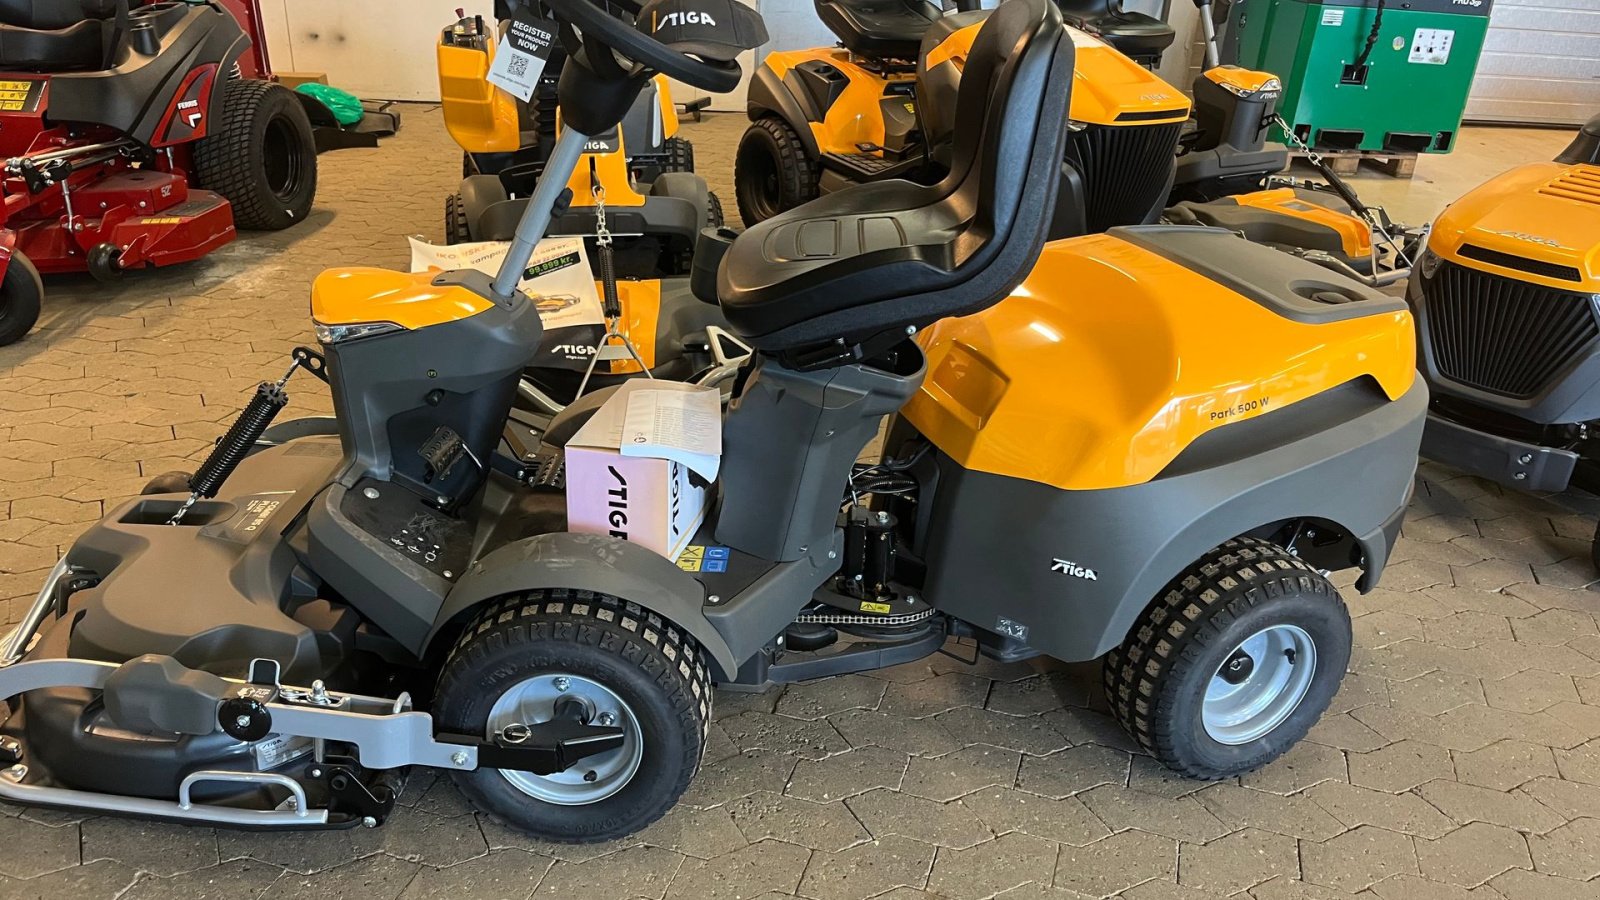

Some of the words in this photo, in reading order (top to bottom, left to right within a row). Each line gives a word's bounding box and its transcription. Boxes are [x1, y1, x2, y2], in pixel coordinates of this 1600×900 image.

[656, 11, 716, 31] STIGA
[511, 28, 526, 39] YOUR
[525, 34, 550, 47] PRODUCT
[513, 21, 552, 41] REGISTER
[517, 38, 539, 52] NOW
[177, 100, 198, 109] FERRIS
[583, 141, 609, 150] TIGA
[528, 260, 560, 275] 99.999
[560, 255, 574, 265] kr.
[551, 344, 598, 355] STIGA
[1210, 408, 1236, 420] Park
[1237, 400, 1258, 414] 500
[1259, 396, 1270, 408] W
[1051, 558, 1097, 580] STIGA
